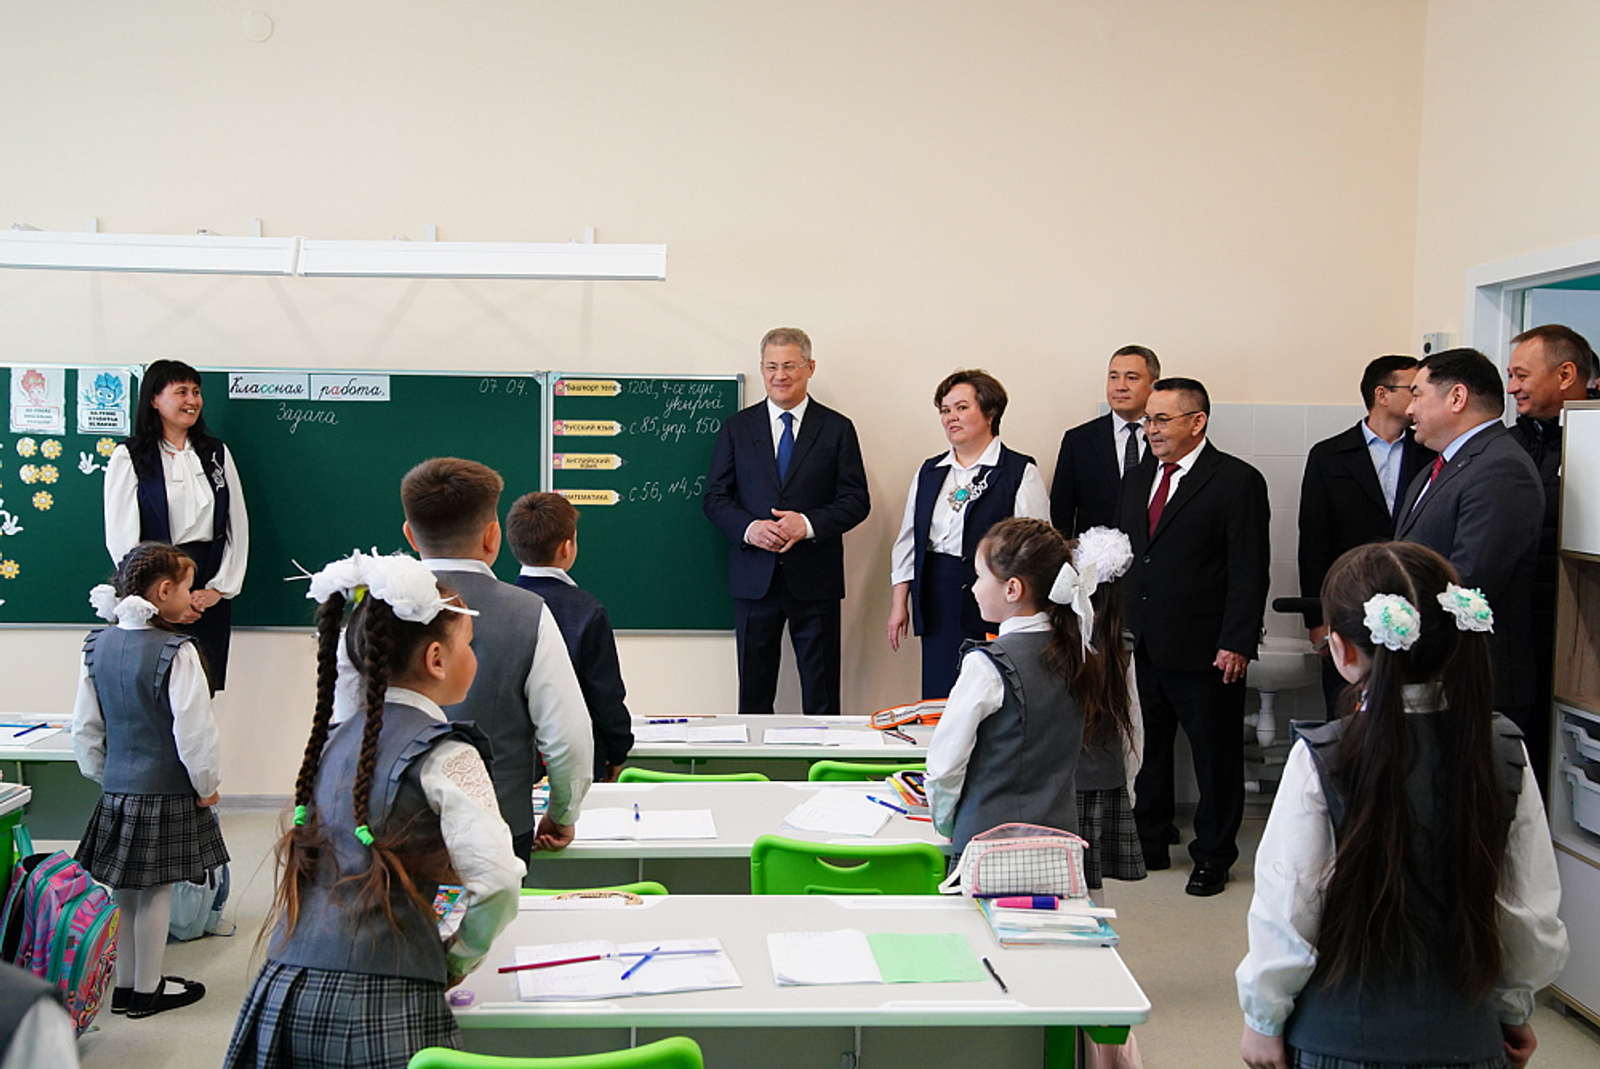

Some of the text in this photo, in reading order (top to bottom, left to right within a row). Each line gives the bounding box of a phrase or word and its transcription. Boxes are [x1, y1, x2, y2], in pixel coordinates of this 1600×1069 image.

[229, 376, 386, 400] Классная работа.
[276, 402, 339, 434] Задача
[696, 417, 721, 434] 150
